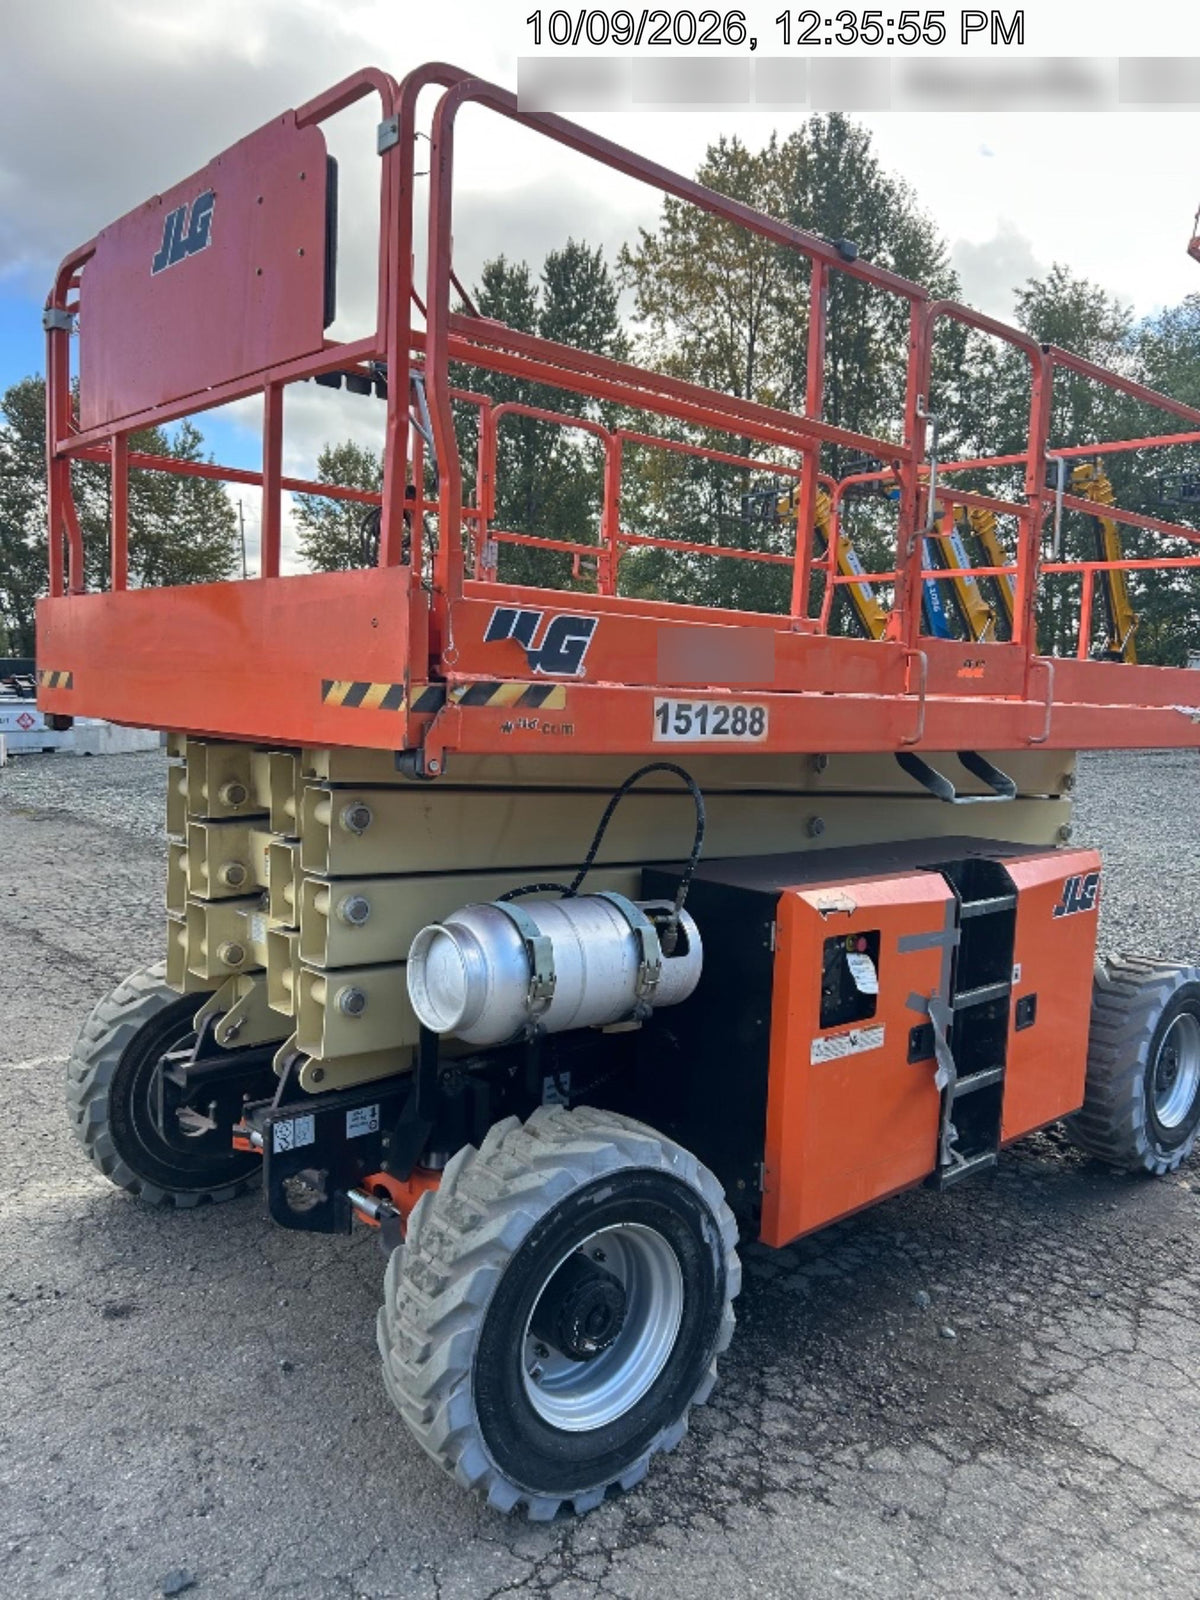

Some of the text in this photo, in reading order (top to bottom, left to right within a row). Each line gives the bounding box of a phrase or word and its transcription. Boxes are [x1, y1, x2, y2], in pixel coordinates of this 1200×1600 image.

[151, 188, 215, 276] JLG
[655, 701, 766, 737] 151288
[1052, 871, 1100, 920] JLG
